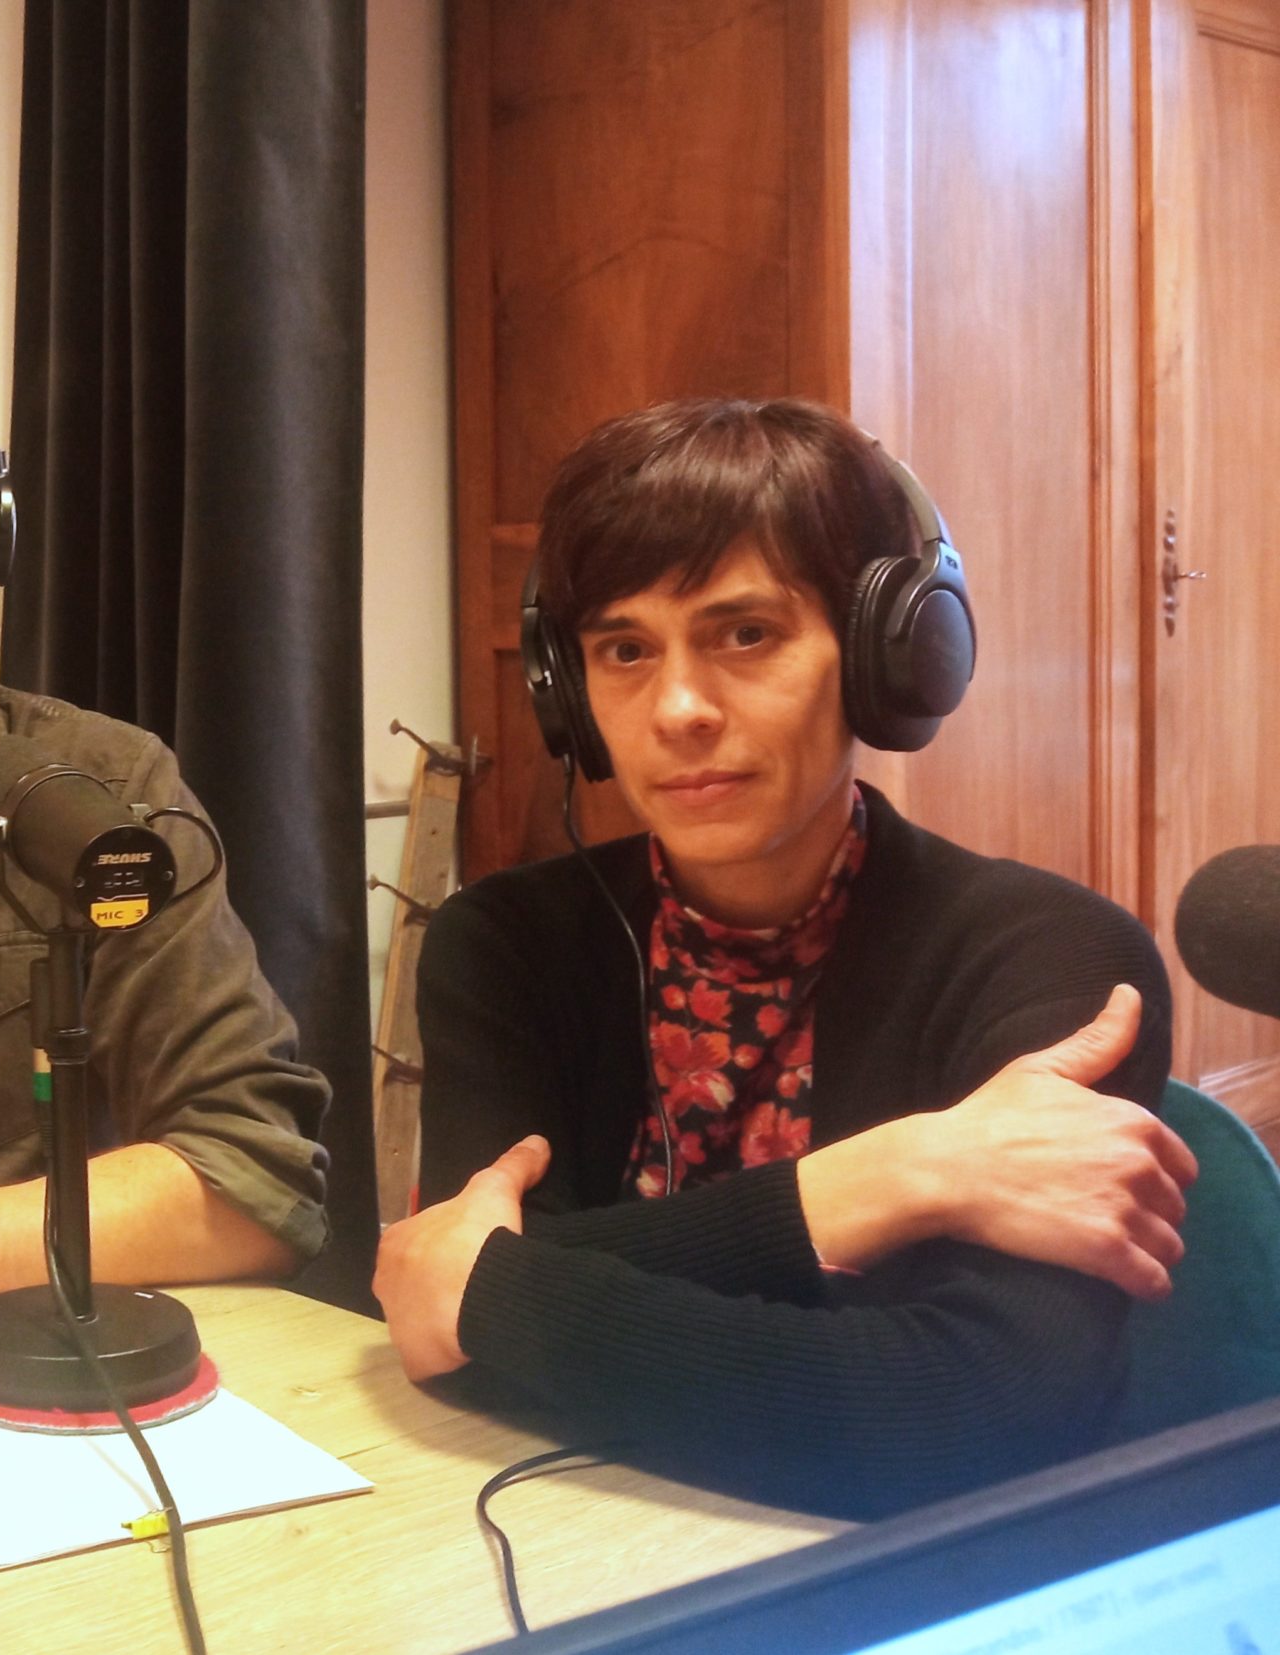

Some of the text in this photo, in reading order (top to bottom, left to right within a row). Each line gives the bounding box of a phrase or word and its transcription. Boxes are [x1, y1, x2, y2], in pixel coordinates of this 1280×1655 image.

[97, 852, 152, 865] SHURE
[96, 909, 144, 921] MIC 3
